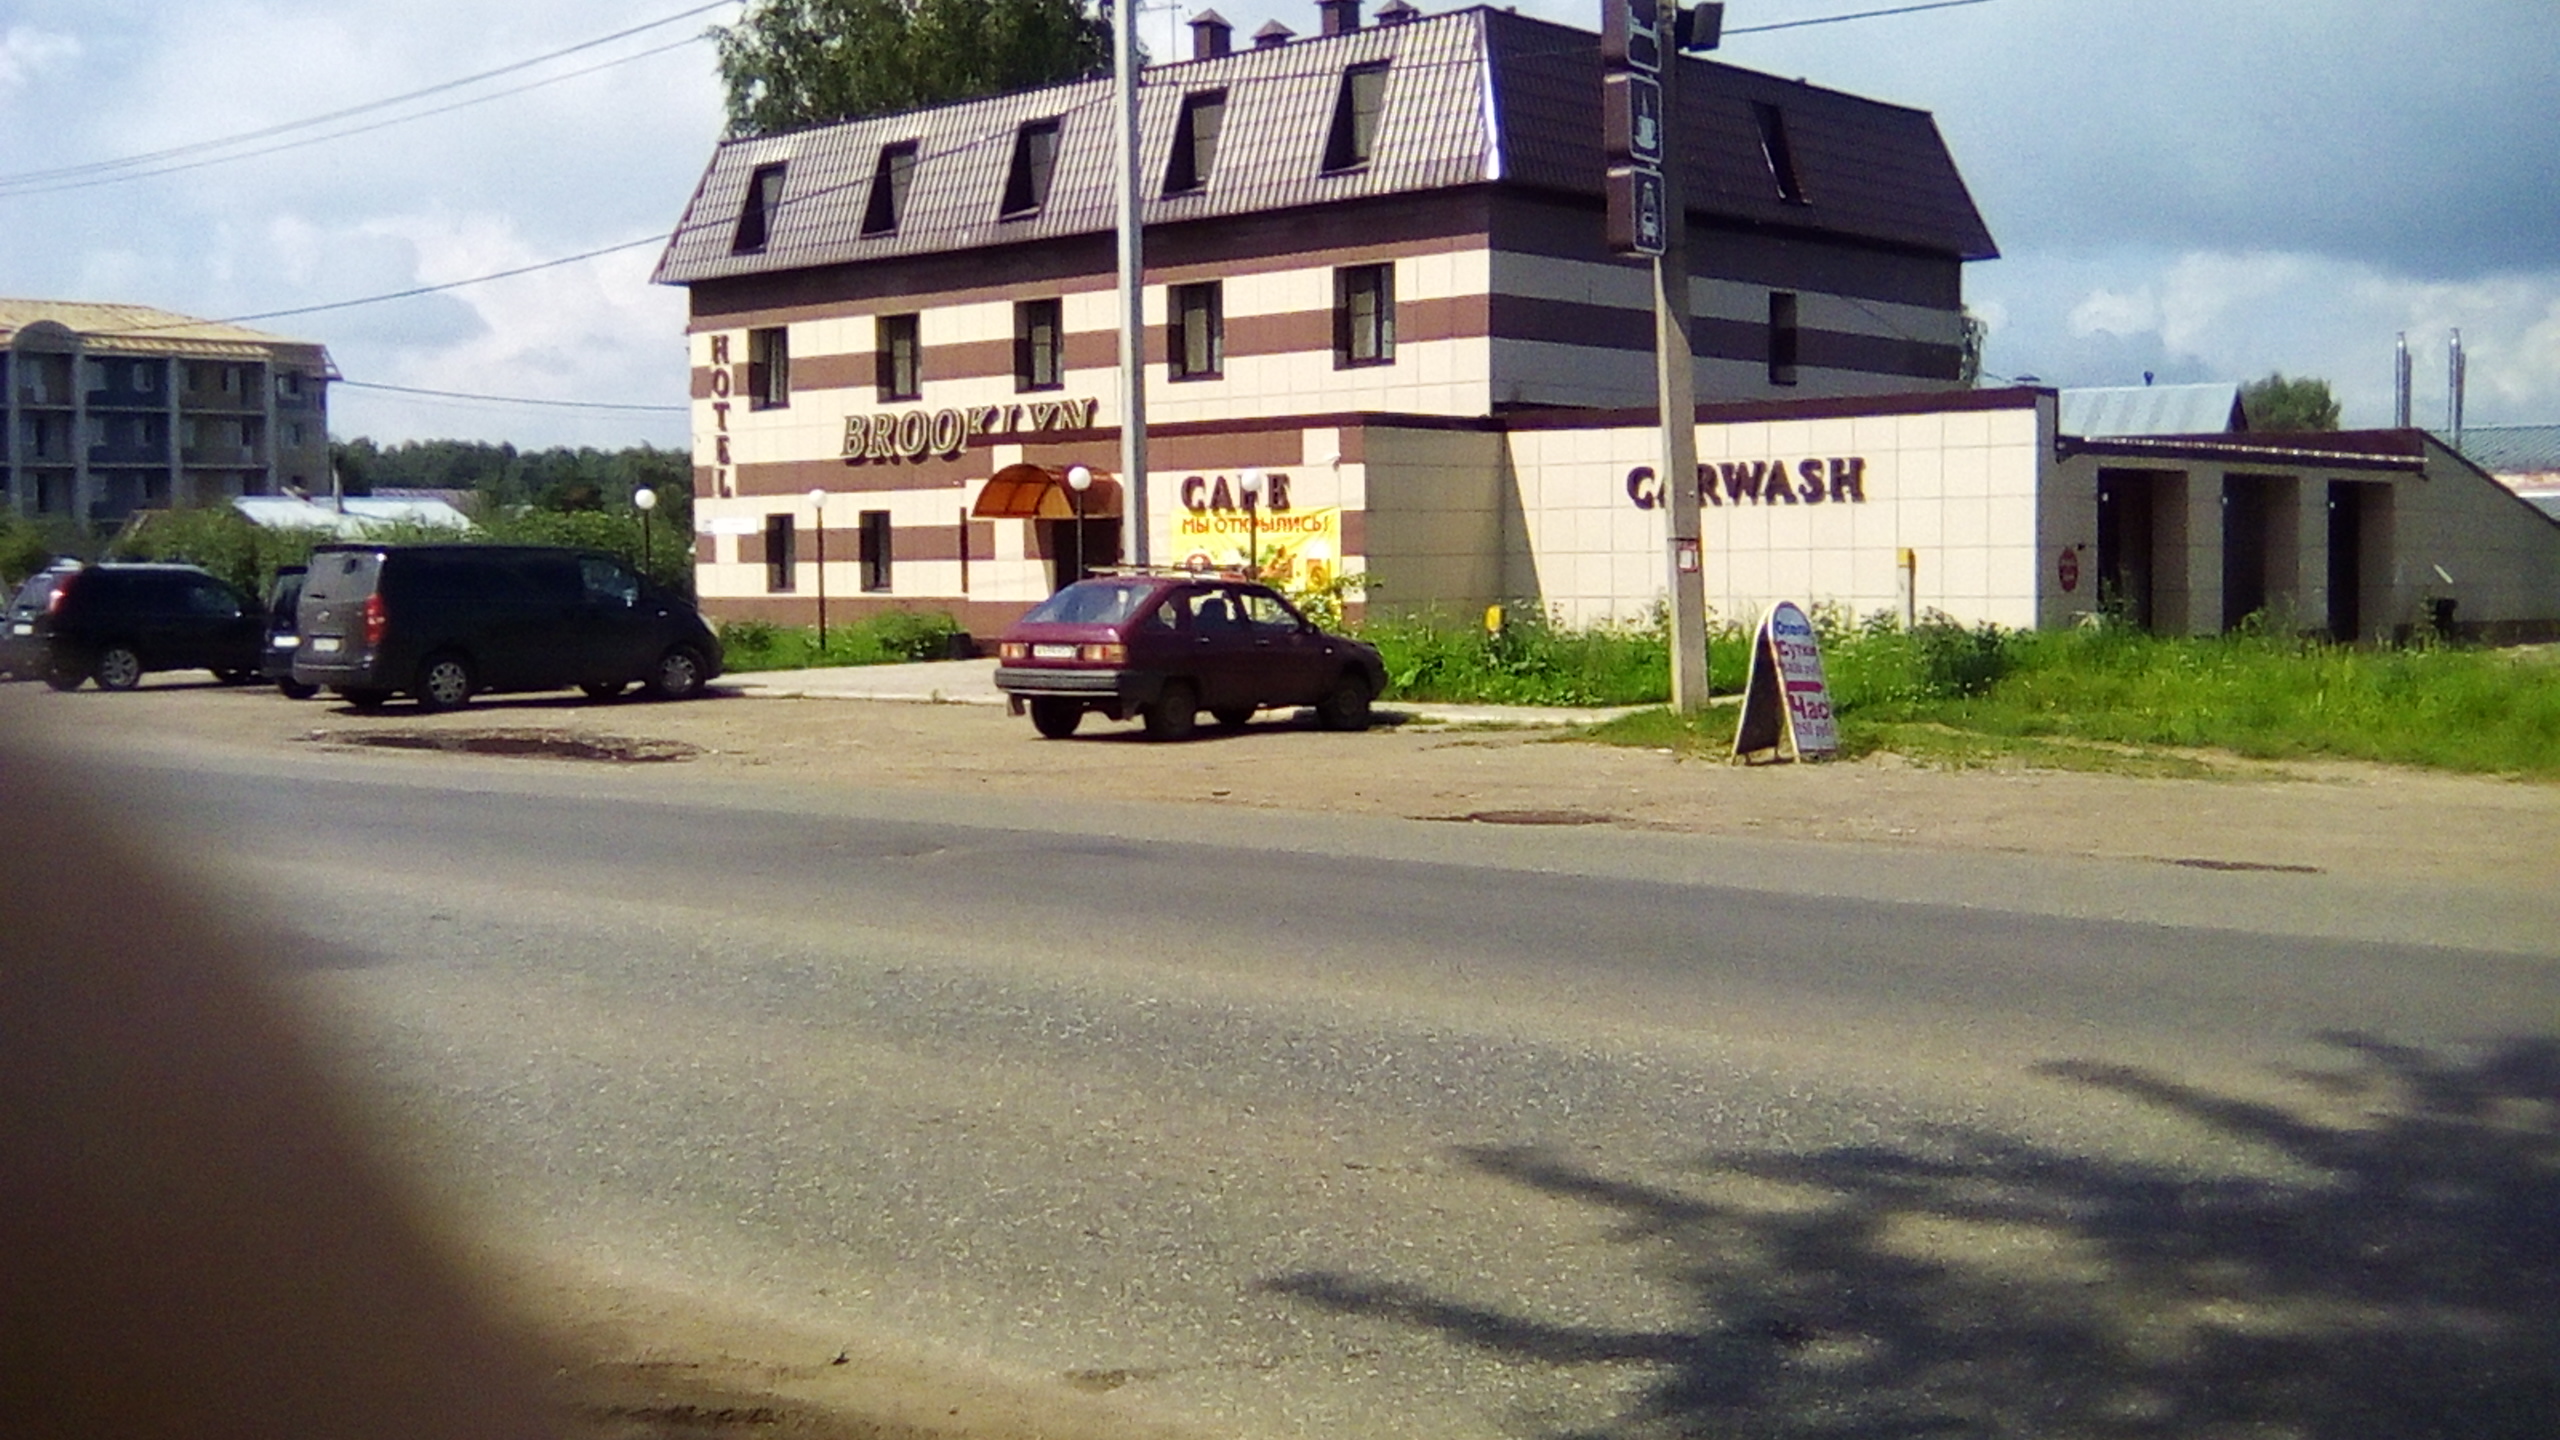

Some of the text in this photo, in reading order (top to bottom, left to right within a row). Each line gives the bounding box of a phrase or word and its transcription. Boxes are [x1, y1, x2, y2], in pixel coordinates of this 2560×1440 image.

[710, 334, 732, 498] HOTEL
[839, 396, 1099, 464] BROOKLYN
[1626, 456, 1867, 510] CRWASH
[1788, 694, 1829, 719] Час
